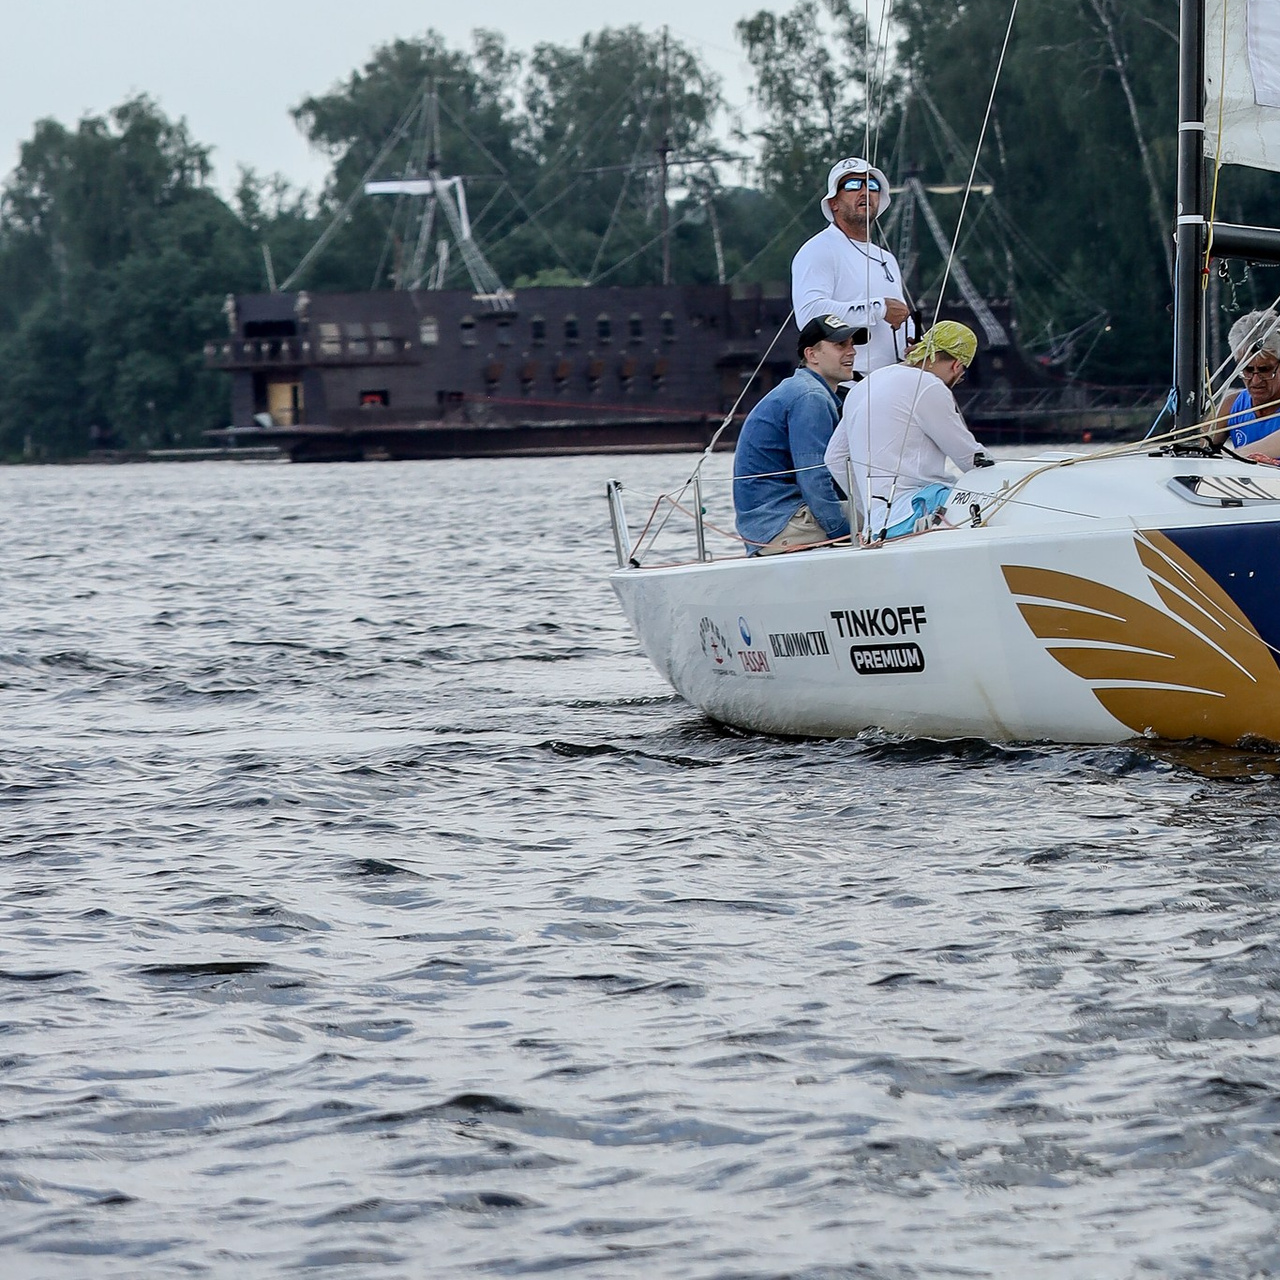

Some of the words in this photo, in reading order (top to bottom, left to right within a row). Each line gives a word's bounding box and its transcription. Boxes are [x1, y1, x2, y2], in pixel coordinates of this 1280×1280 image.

[829, 605, 927, 638] TINKOFF
[737, 651, 771, 673] TASSAY
[853, 648, 921, 670] PREMIUM
